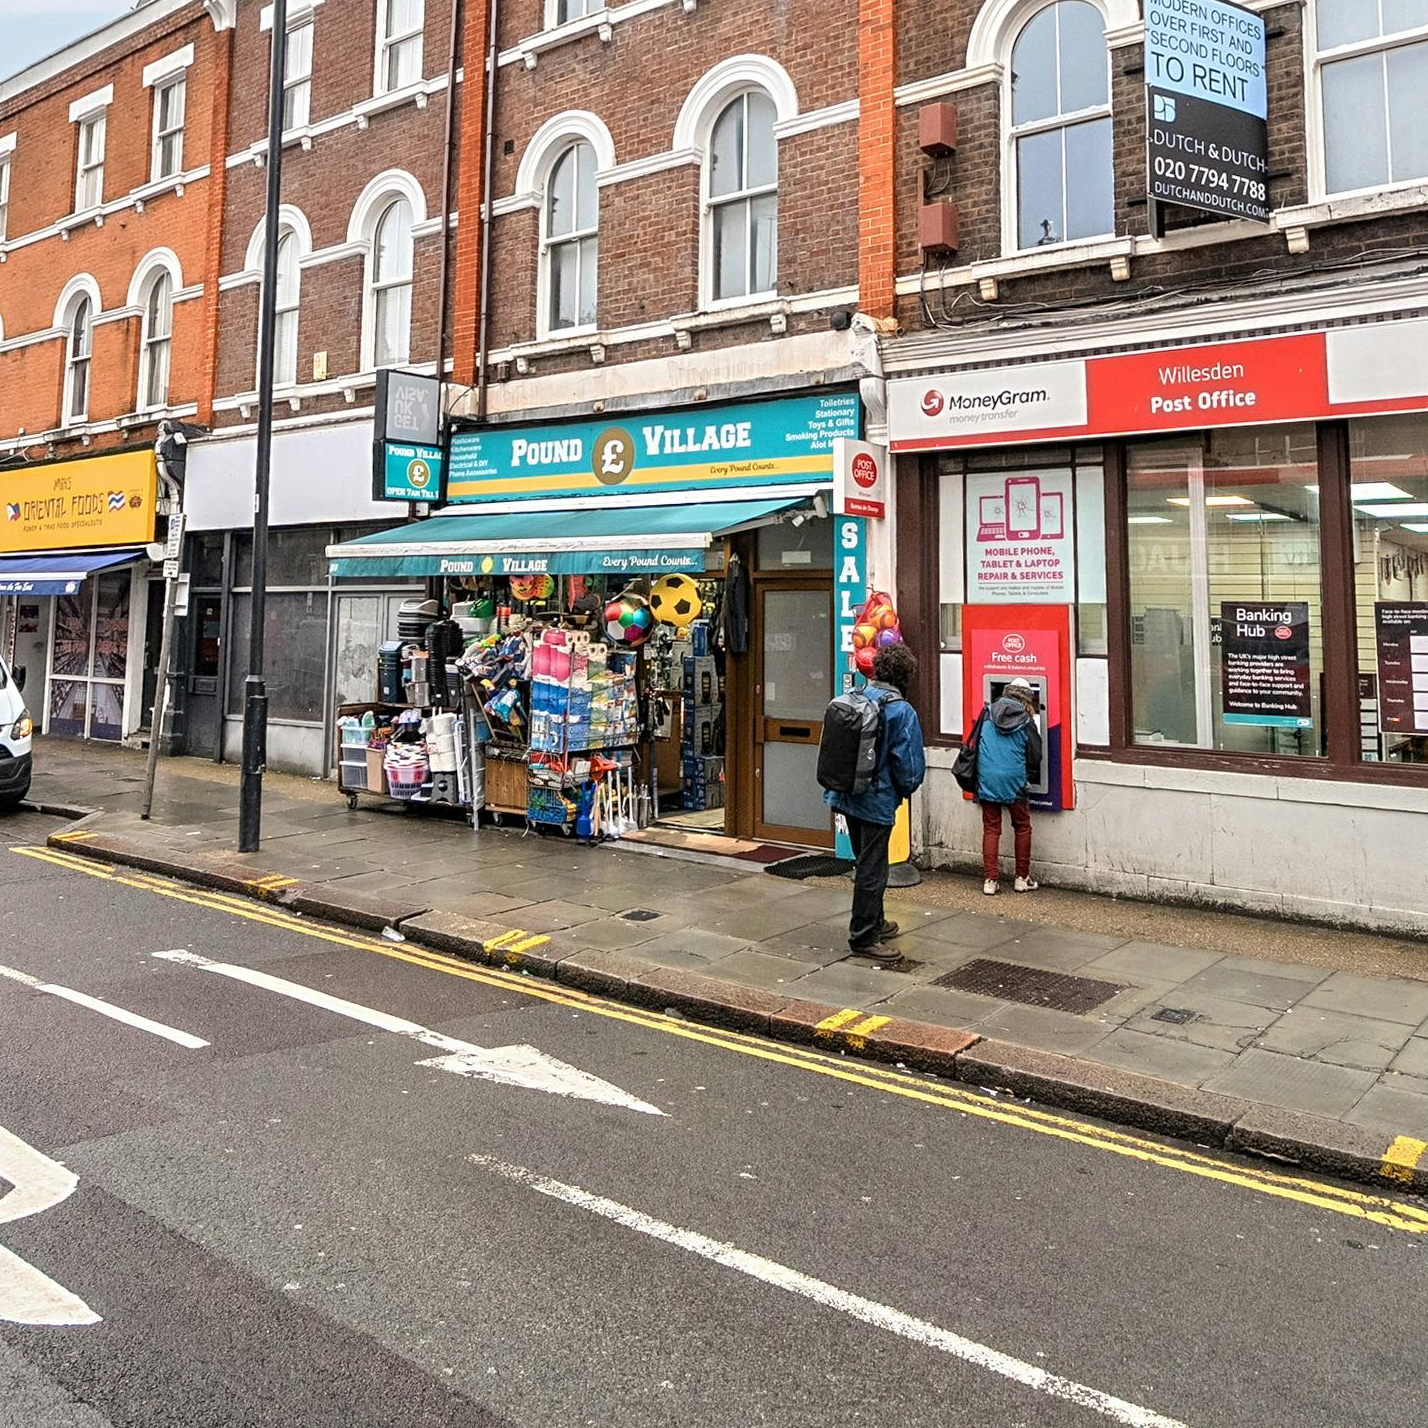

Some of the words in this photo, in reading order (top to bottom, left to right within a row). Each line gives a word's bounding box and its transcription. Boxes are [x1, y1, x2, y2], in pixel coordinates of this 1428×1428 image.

[1150, 10, 1187, 33] OVER
[1191, 22, 1225, 45] FIRST
[1229, 35, 1252, 55] AND
[1211, 10, 1261, 40] OFFICES
[1150, 30, 1208, 58] SECOND
[1212, 48, 1260, 77] FLOORS
[1151, 51, 1184, 82] TO
[1193, 63, 1248, 102] RENT
[1154, 129, 1205, 155] DUTCH
[1208, 143, 1220, 160] &
[1222, 146, 1265, 172] DUTCH
[1154, 156, 1186, 180] 020
[1189, 164, 1228, 190] 7794
[1232, 174, 1266, 201] 7788
[1154, 181, 1266, 218] DUTCHANDDUTCH.COM
[1158, 362, 1244, 385] Willesden
[820, 397, 855, 408] Toiletries
[948, 388, 1048, 411] MoneyGram
[1150, 394, 1192, 415] Post
[1197, 389, 1257, 410] Office
[815, 407, 855, 418] Stationary
[949, 413, 980, 424] money
[981, 408, 1018, 421] transfer
[808, 420, 826, 430] Toys
[827, 419, 834, 427] &
[836, 418, 855, 426] Gifts
[785, 432, 818, 442] Smoking
[819, 428, 855, 438] Products
[388, 445, 415, 458] POUND
[511, 437, 583, 467] POUND
[601, 439, 624, 475] £
[642, 422, 752, 456] VILLAGE
[811, 440, 827, 449] Alot
[729, 462, 751, 472] Pound
[857, 459, 873, 469] POST
[853, 469, 875, 481] OFFICE
[23, 497, 66, 521] ORIENTAL
[72, 492, 104, 515] FOODS
[985, 548, 1019, 557] MOBILE
[1020, 547, 1055, 556] PHONE,
[440, 559, 474, 573] POUND
[503, 557, 548, 572] VILLAGE
[603, 556, 628, 571] Every
[629, 554, 659, 566] Pound
[980, 560, 1014, 568] TABLET
[1015, 560, 1022, 568] &
[1024, 559, 1060, 568] LAPTOP
[977, 572, 1009, 581] REPAIR
[1010, 572, 1017, 580] &
[1019, 571, 1064, 579] SERVICES
[1236, 608, 1292, 624] Banking
[1237, 624, 1266, 637] Hub
[992, 652, 1013, 662] Free
[1014, 653, 1037, 663] cash
